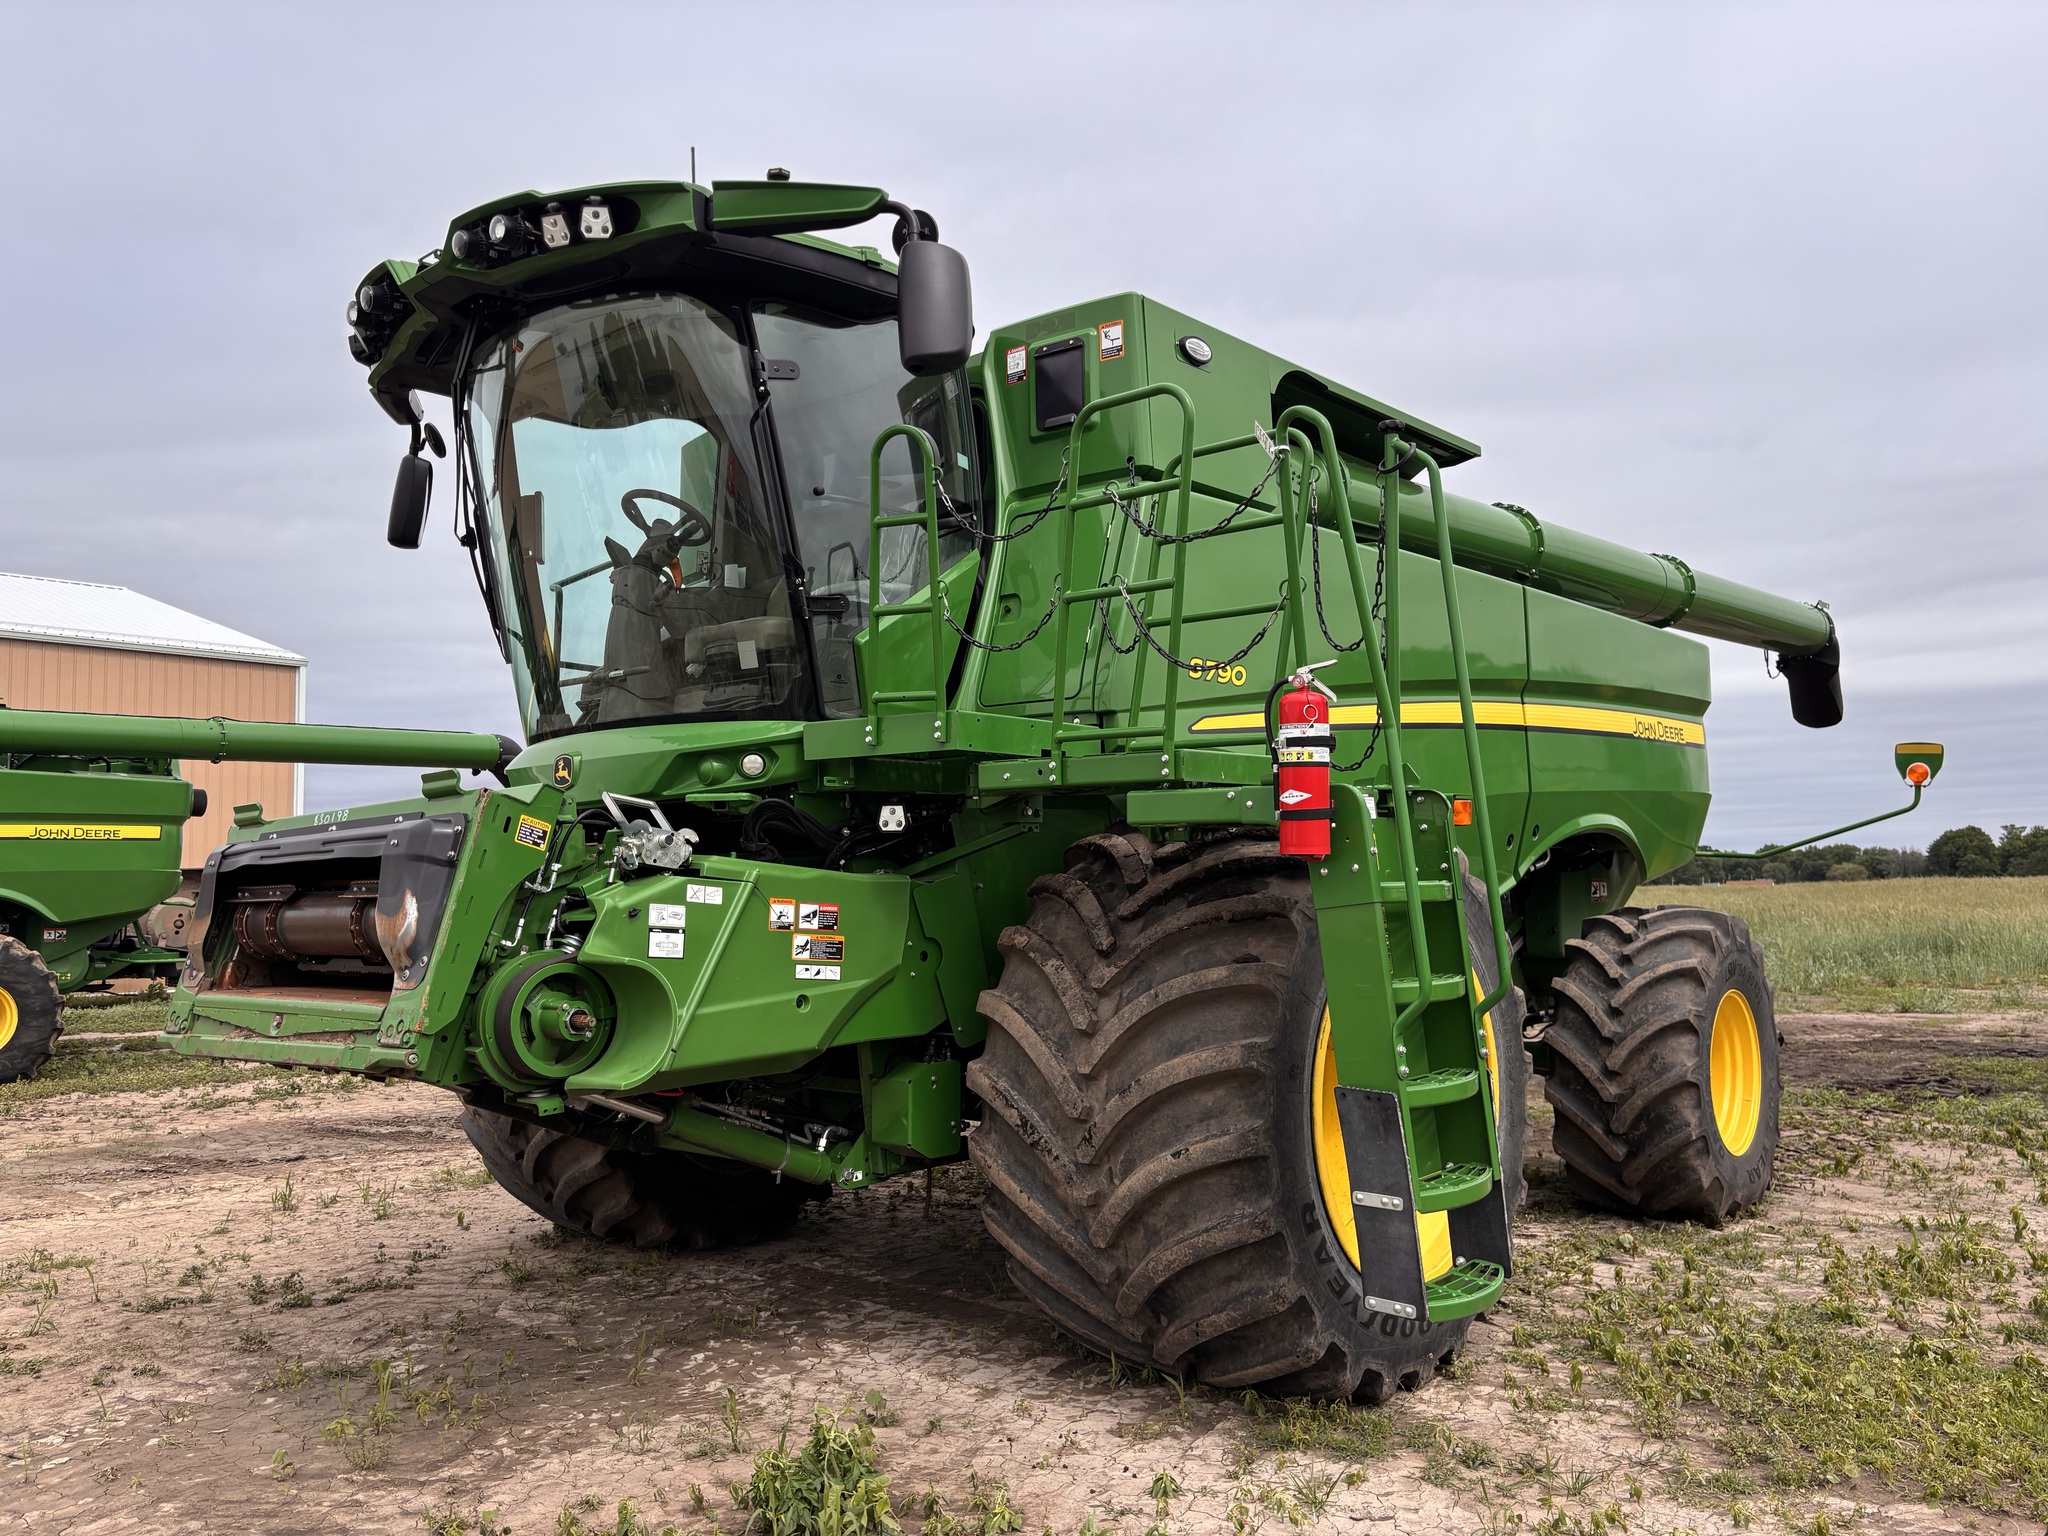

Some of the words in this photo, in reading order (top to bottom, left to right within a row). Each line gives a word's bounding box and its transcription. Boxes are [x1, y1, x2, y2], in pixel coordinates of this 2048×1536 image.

[1633, 717, 1657, 738] JOHN
[1657, 721, 1685, 741] DEERE
[28, 826, 70, 838] JOHN
[73, 827, 121, 838] DEERE
[525, 817, 550, 830] CAUTION
[1302, 1199, 1445, 1338] OODYEAR
